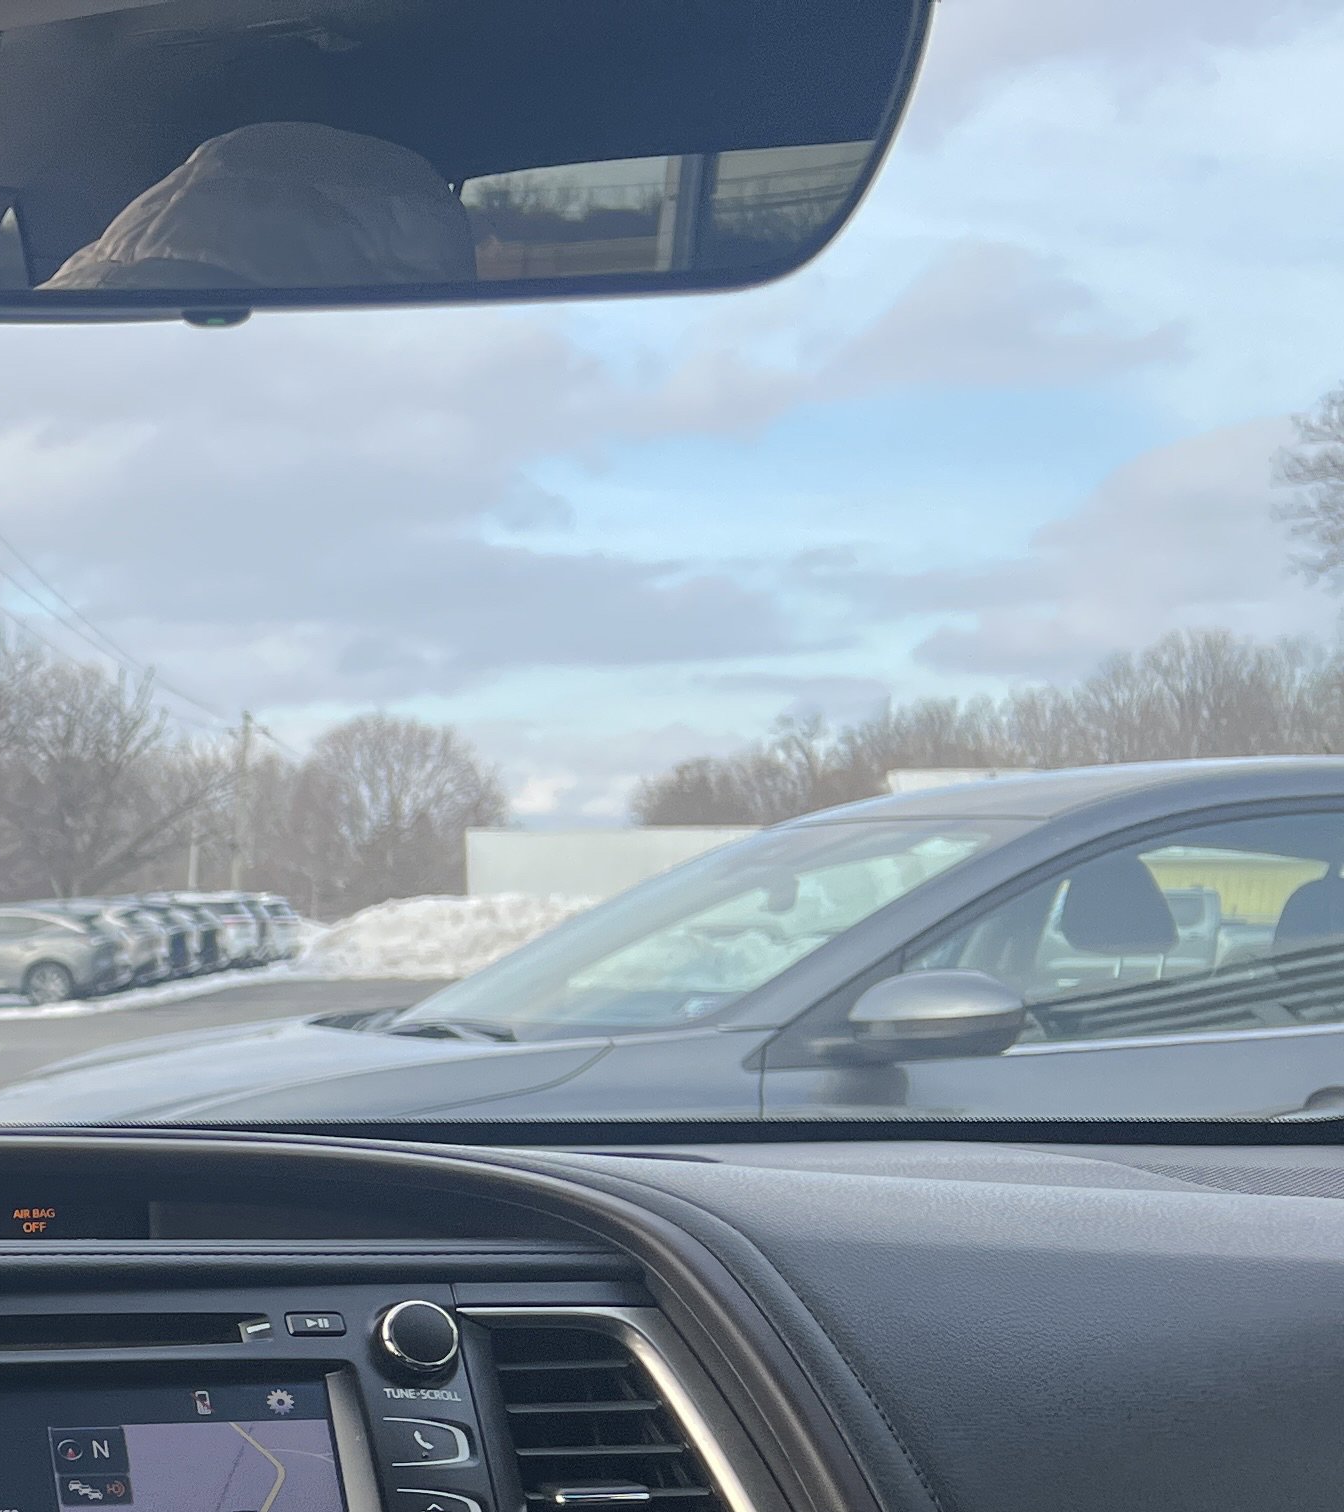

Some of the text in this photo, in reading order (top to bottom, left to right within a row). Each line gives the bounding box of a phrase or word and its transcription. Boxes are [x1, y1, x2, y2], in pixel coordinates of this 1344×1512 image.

[13, 1208, 56, 1219] AIR BAG
[22, 1221, 48, 1233] OFF
[91, 1440, 111, 1459] N
